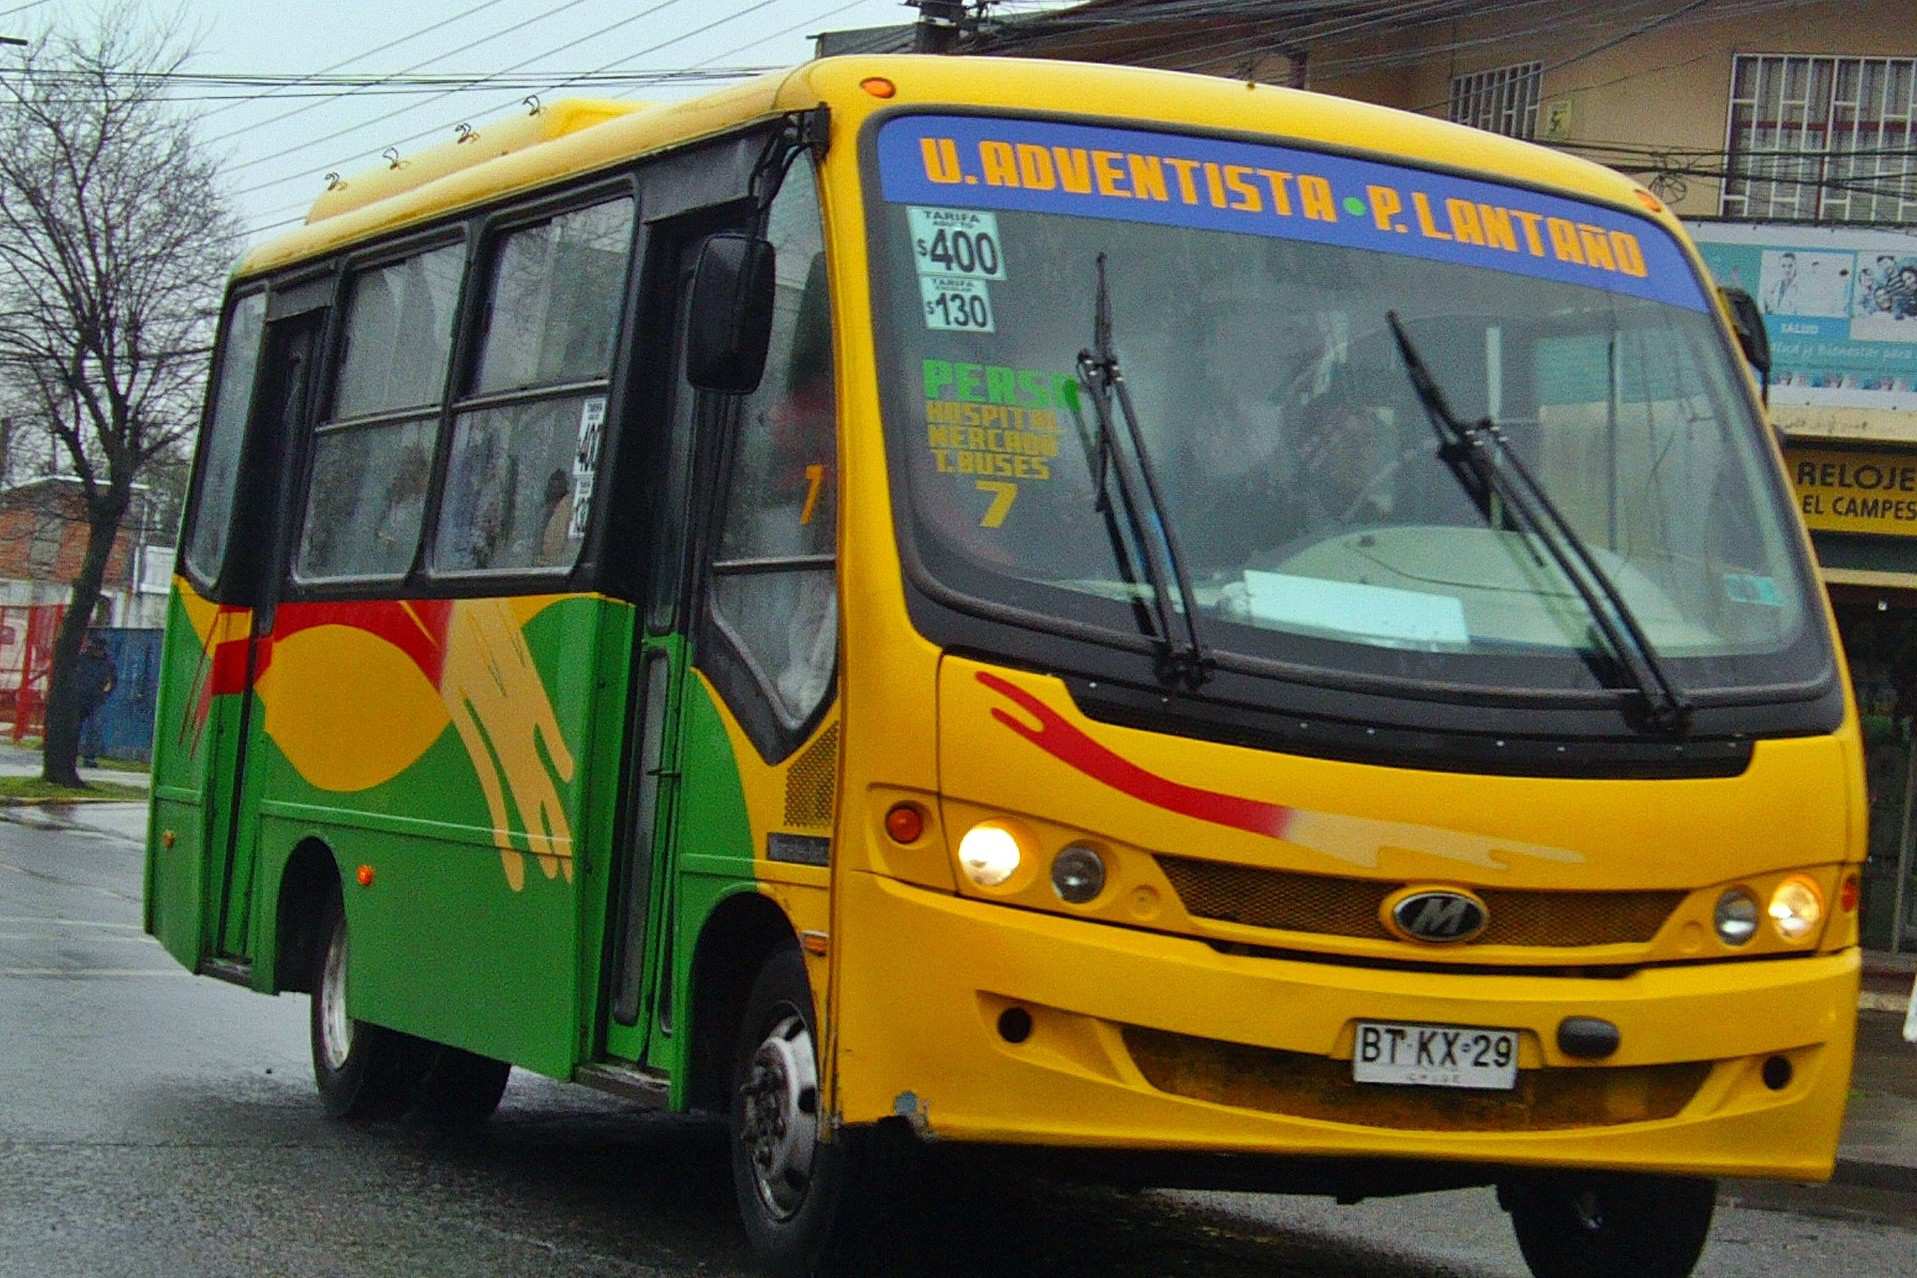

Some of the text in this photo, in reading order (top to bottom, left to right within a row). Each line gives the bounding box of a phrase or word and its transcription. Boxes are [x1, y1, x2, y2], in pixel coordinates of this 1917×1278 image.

[923, 209, 980, 223] TARIFA
[916, 228, 999, 275] $400
[926, 291, 988, 328] $130
[1797, 461, 1917, 491] RELOJE
[975, 480, 1018, 528] 7
[1802, 494, 1825, 514] EL
